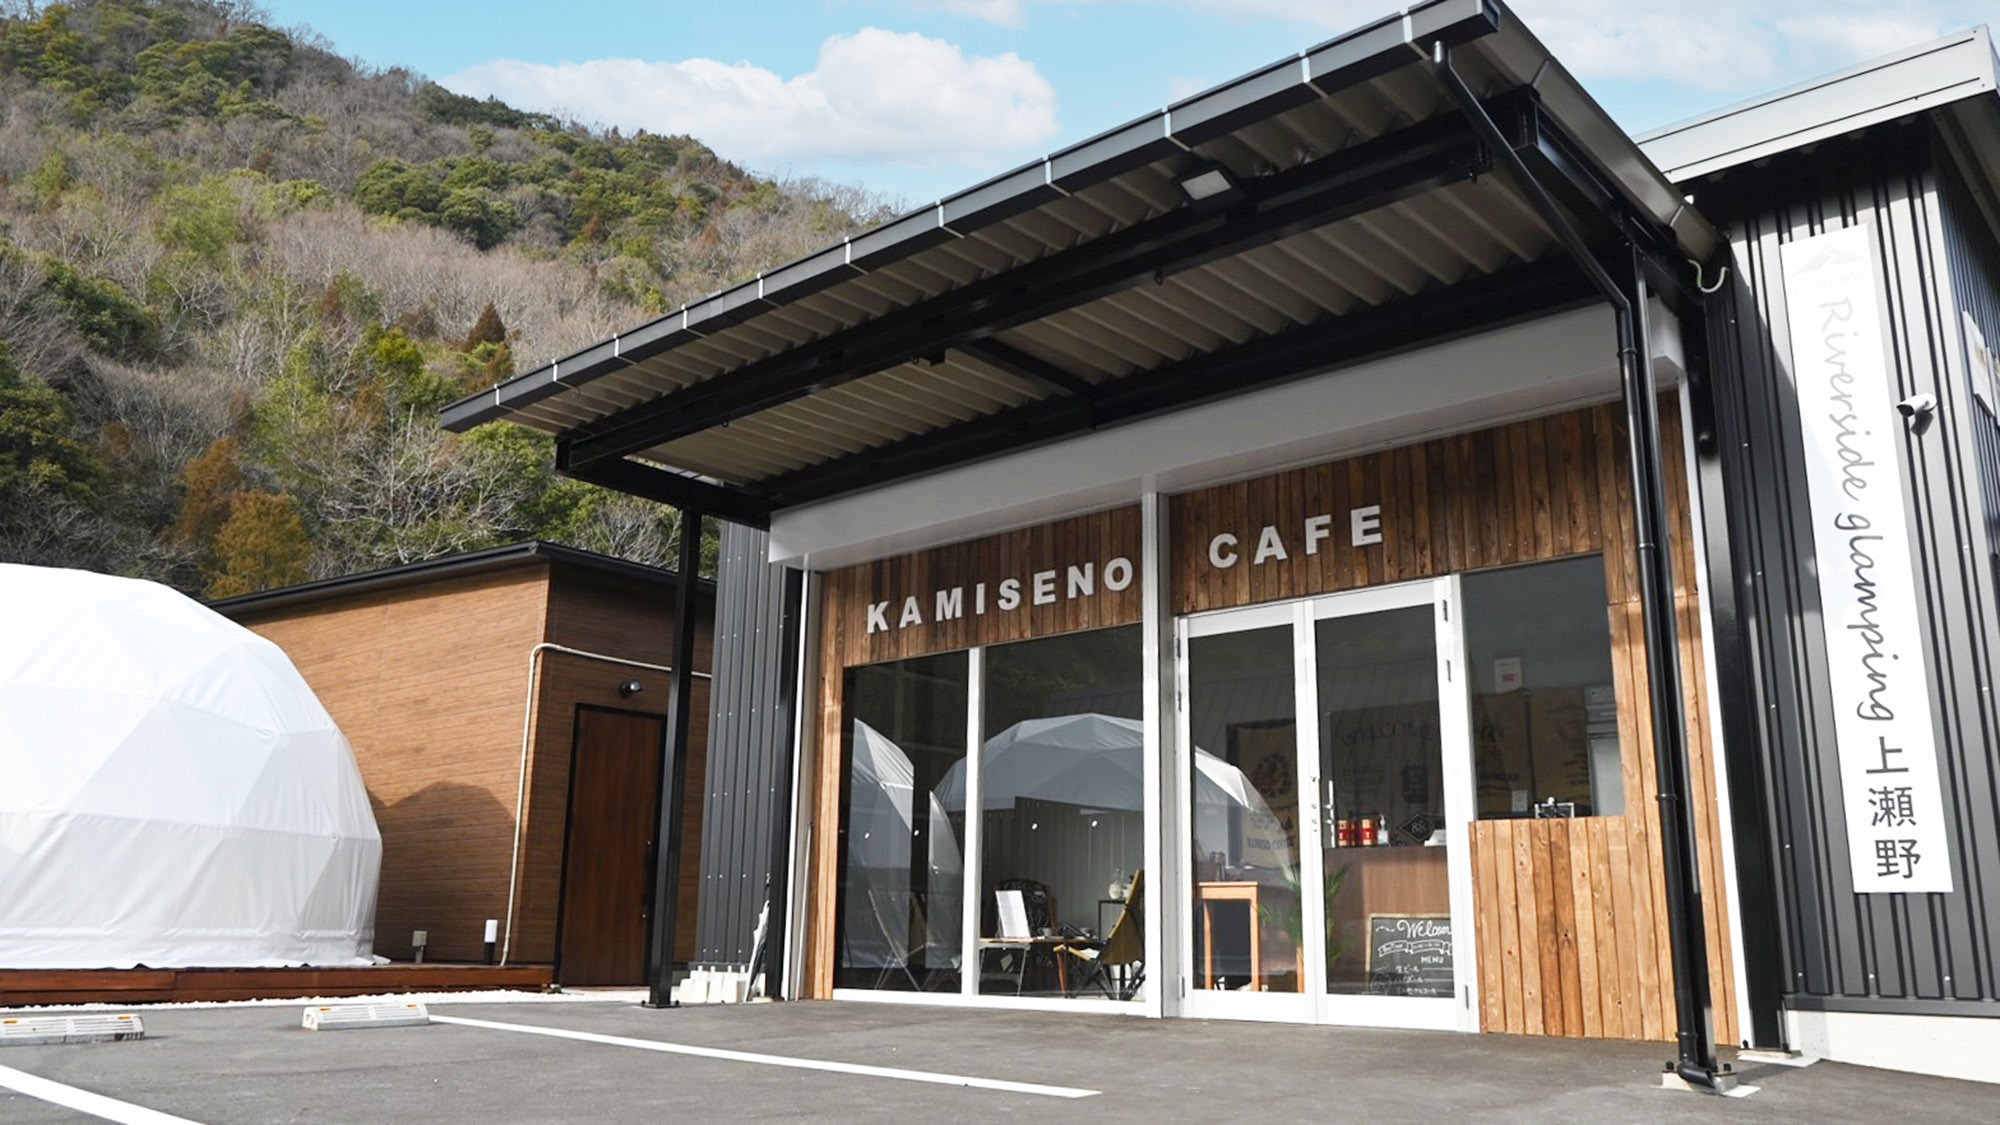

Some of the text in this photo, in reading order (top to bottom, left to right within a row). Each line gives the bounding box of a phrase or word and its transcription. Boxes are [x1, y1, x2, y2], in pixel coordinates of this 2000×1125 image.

[1819, 297, 1875, 502] Riverside
[867, 504, 1383, 635] KAMISENO CAFE
[1834, 512, 1899, 722] glamping
[1866, 736, 1921, 879] 上瀬野
[1397, 920, 1452, 938] Welcom
